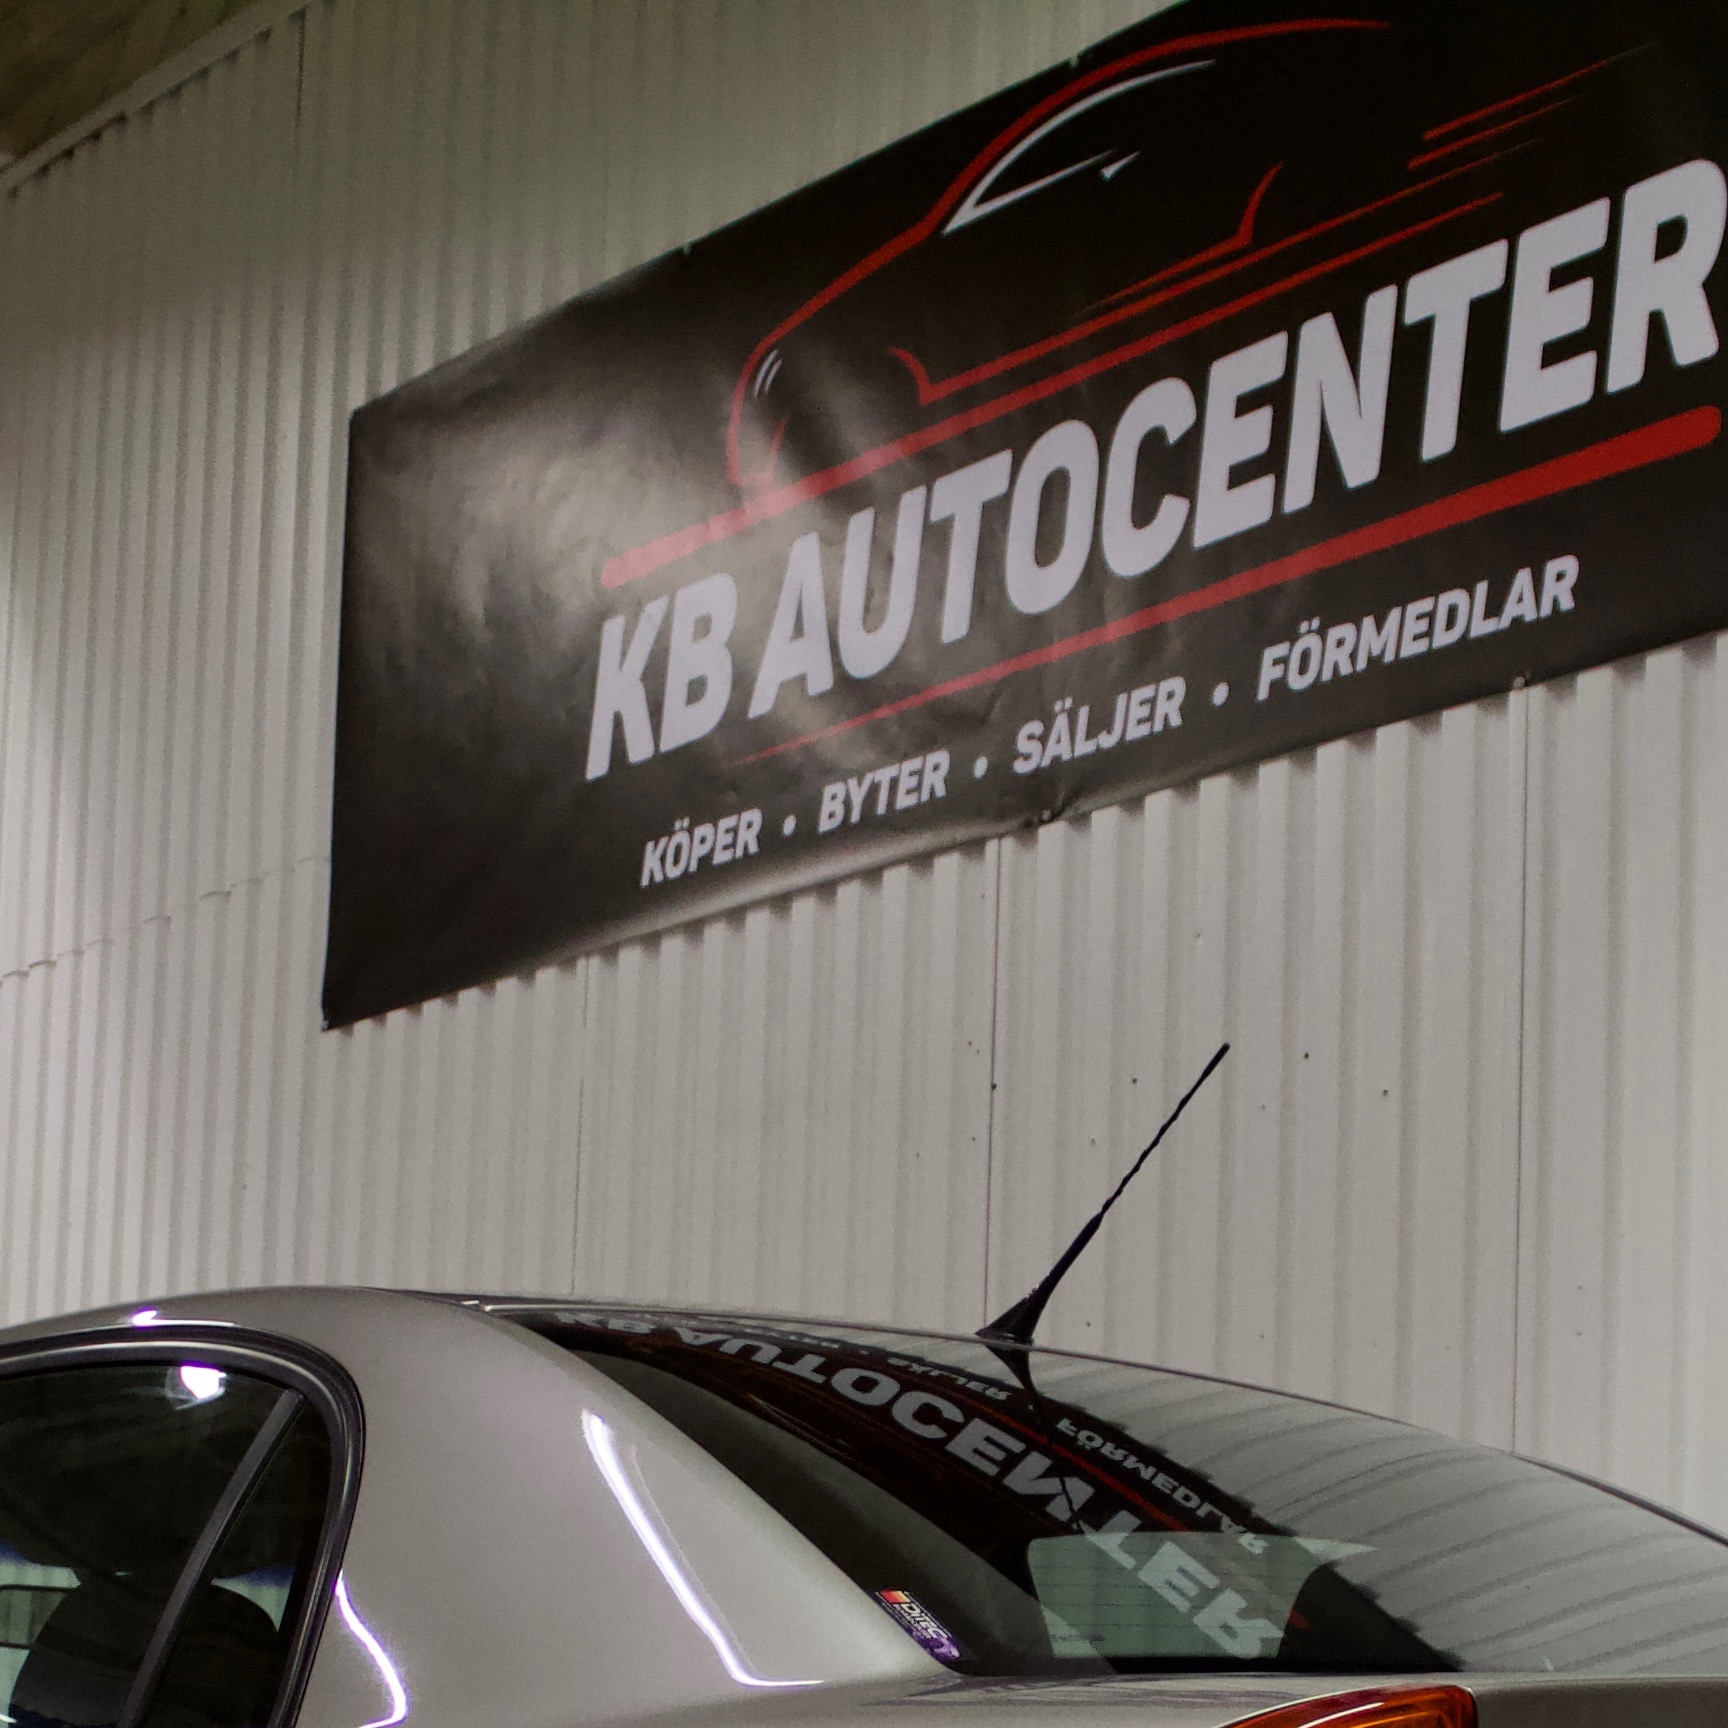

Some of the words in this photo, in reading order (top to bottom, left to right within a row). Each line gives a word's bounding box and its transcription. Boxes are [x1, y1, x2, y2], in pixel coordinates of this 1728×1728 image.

[586, 572, 739, 780] KB
[748, 158, 1728, 719] AUTOCENTER
[639, 807, 762, 888] KÖPER
[817, 750, 952, 835] BYTER
[1012, 676, 1186, 775] SÄLJER
[1256, 555, 1581, 703] FÖRMEDLAR
